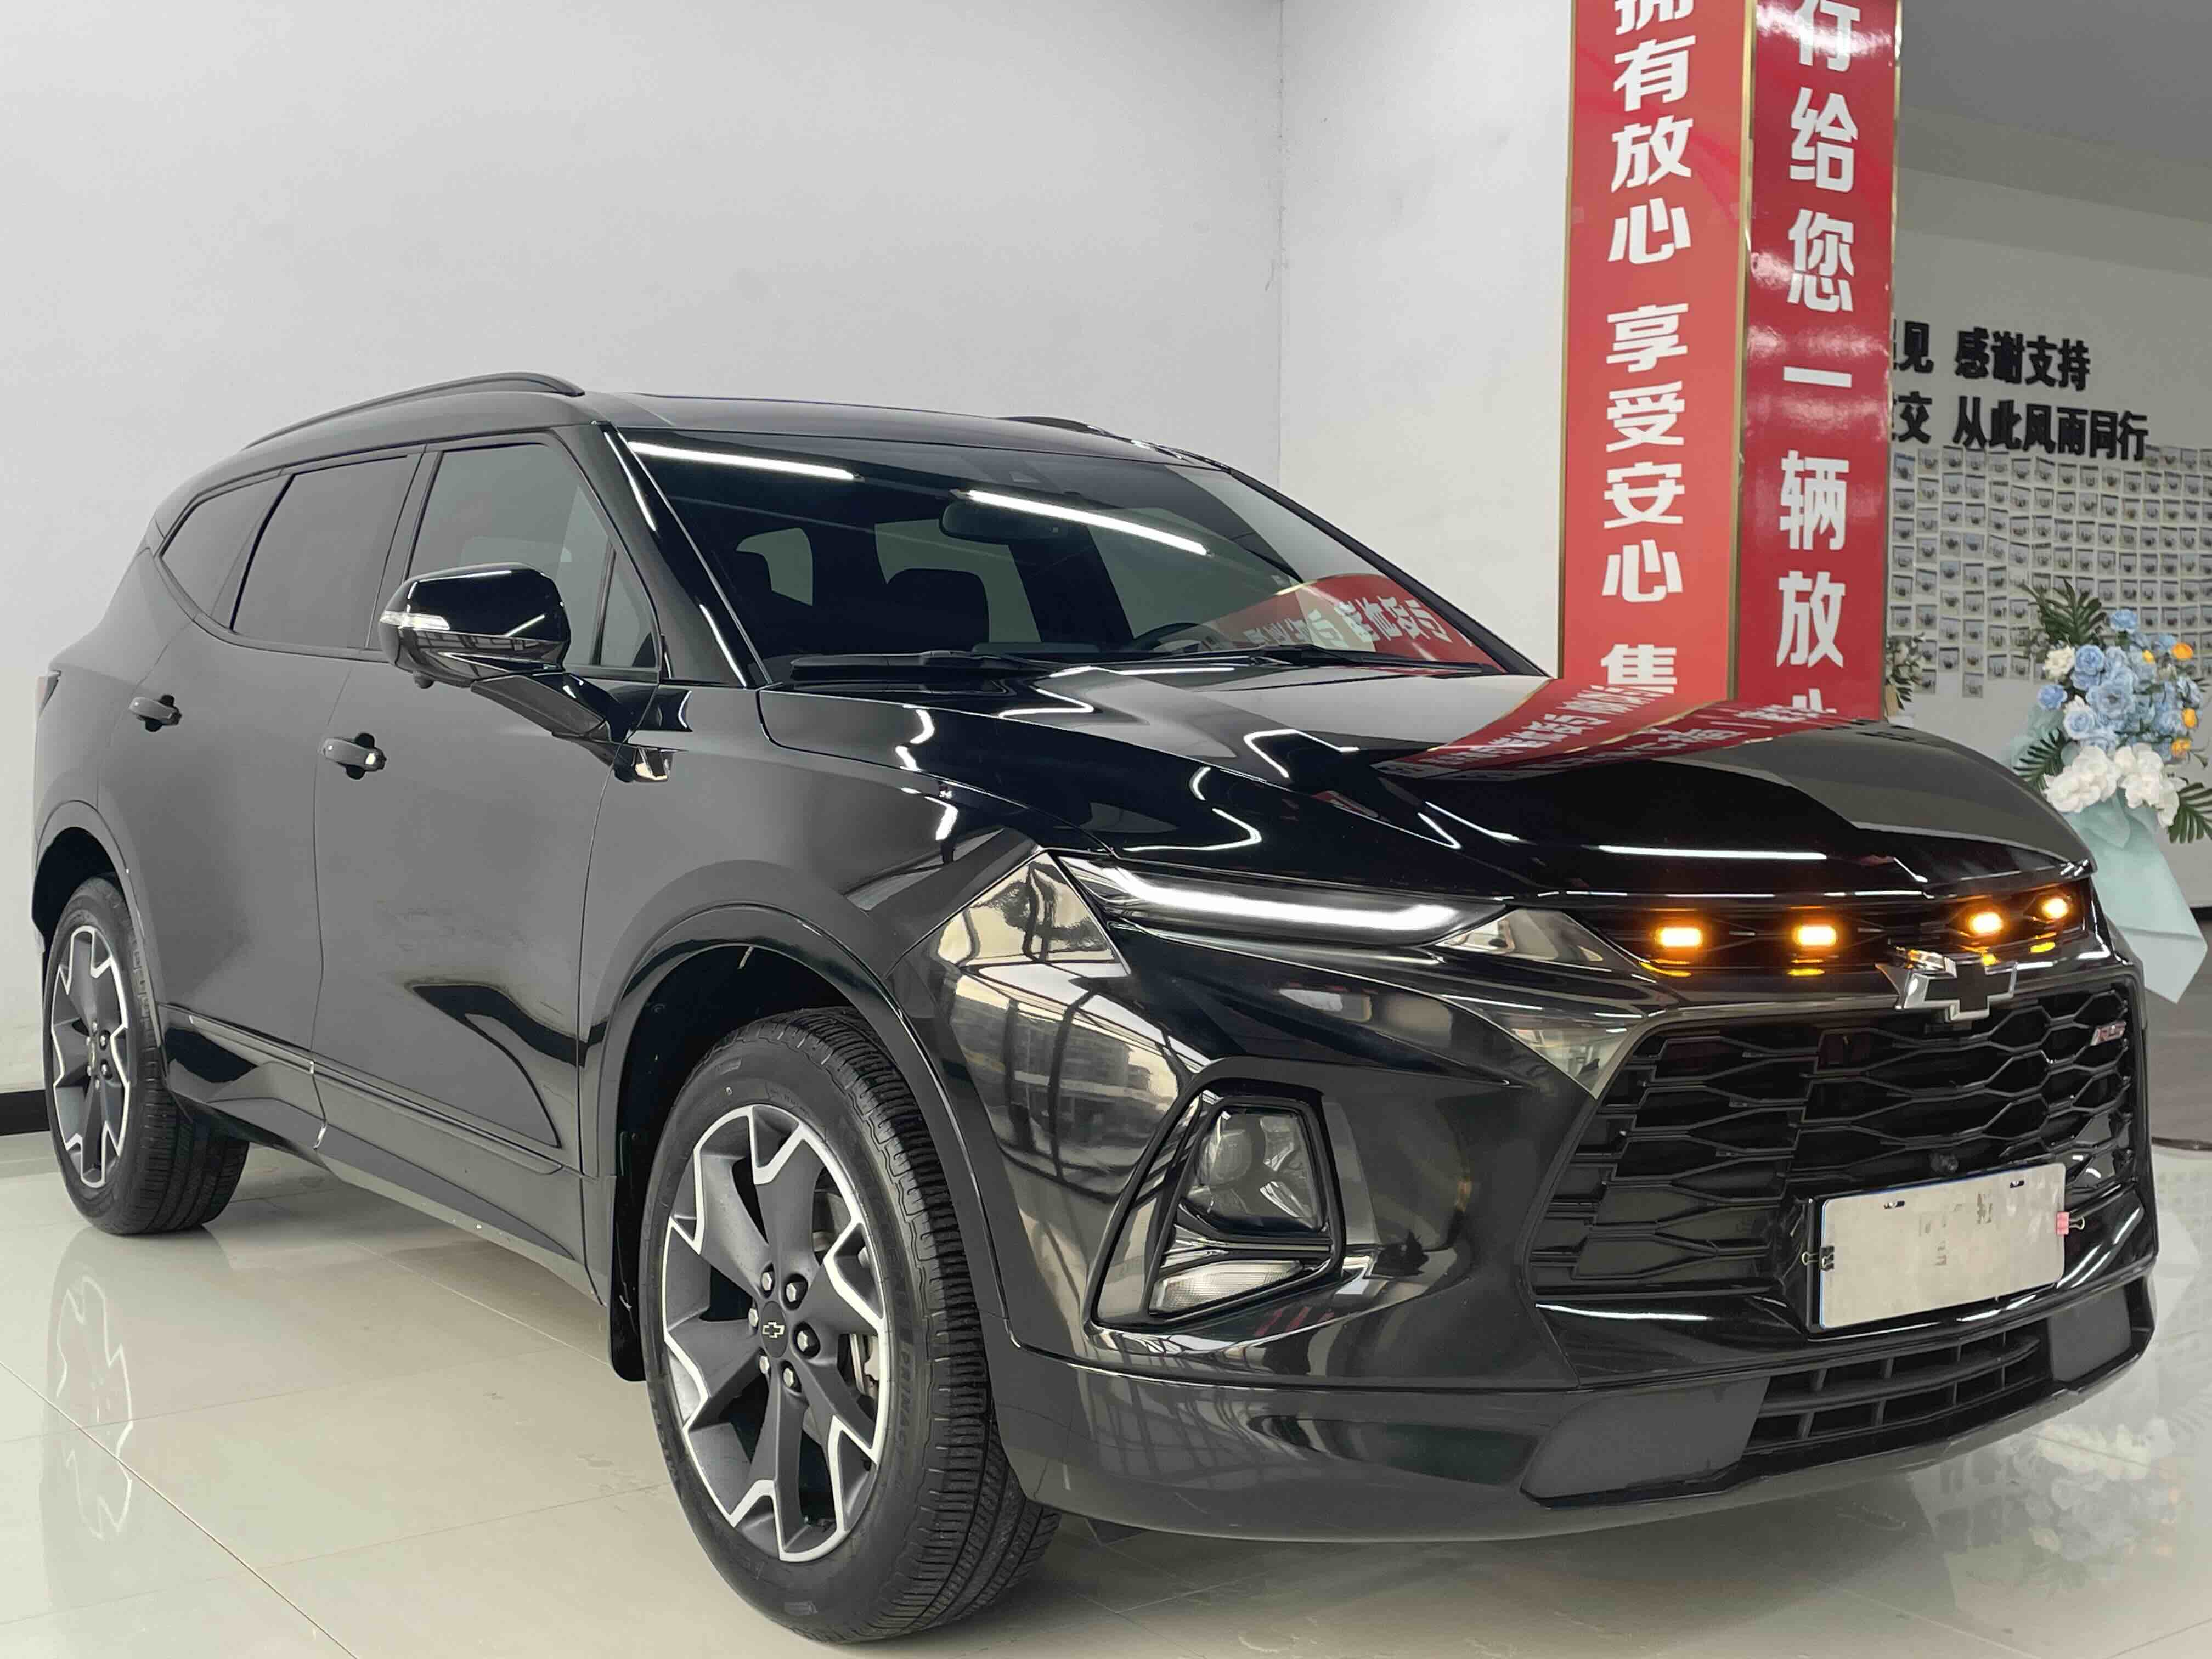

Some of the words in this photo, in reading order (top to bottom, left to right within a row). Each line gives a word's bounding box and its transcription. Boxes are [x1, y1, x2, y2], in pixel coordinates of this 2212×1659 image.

[1955, 326, 2091, 391] 感谢支持
[1953, 396, 2149, 461] 从此风雨同行
